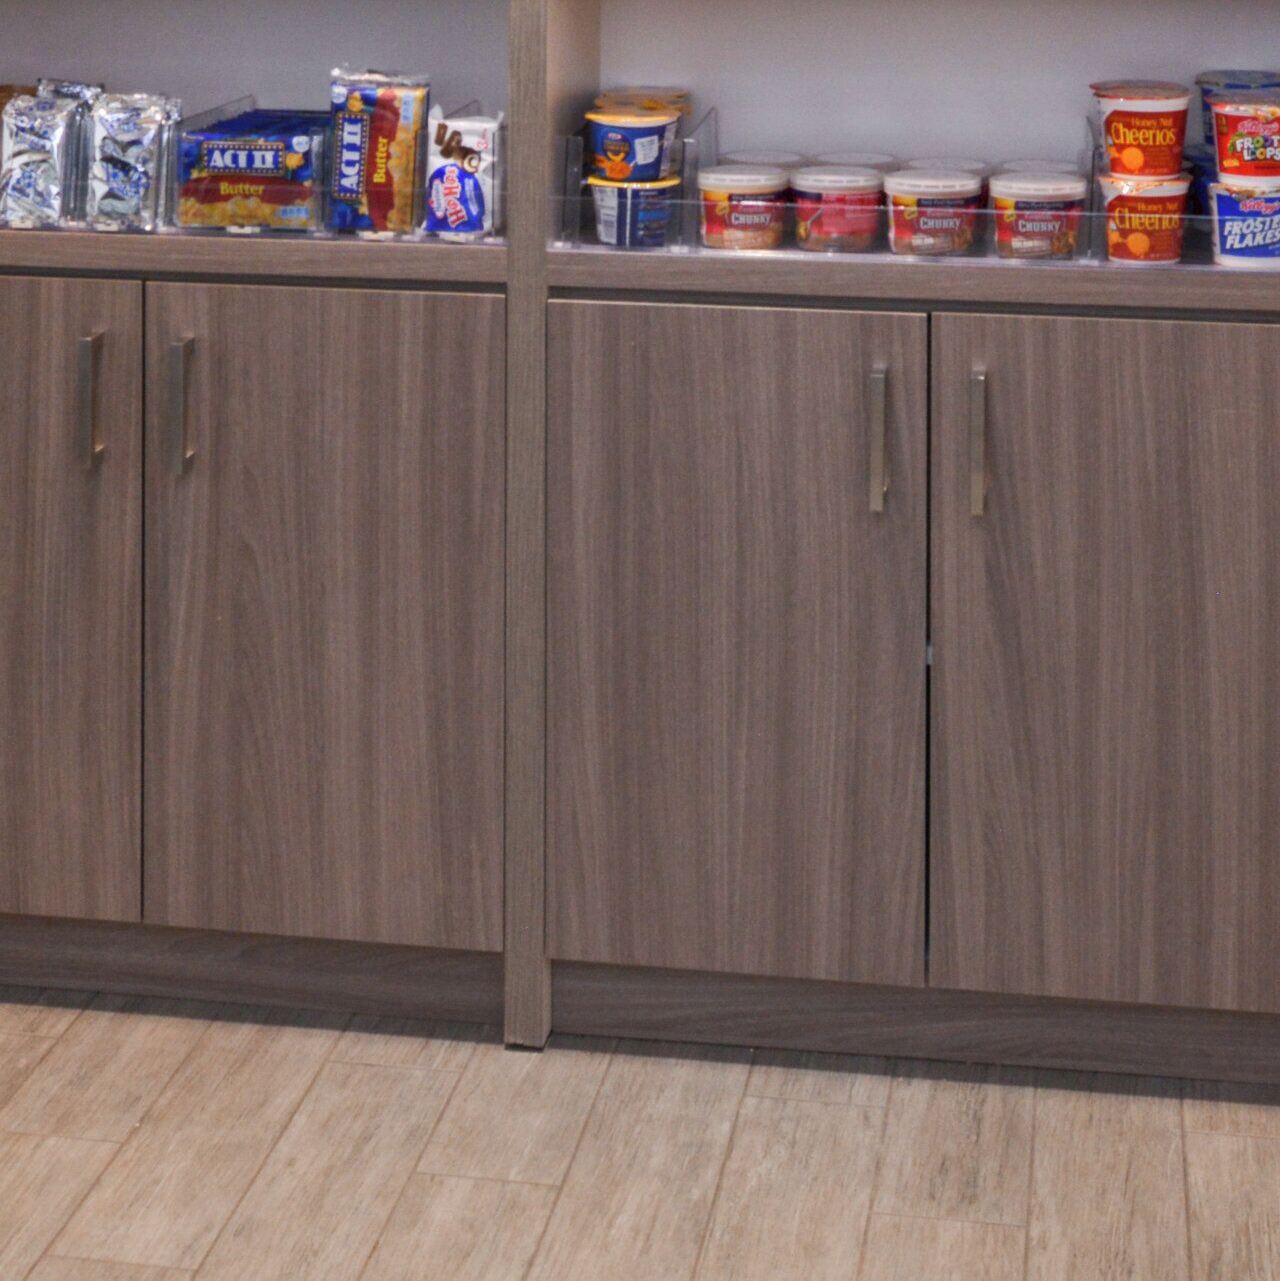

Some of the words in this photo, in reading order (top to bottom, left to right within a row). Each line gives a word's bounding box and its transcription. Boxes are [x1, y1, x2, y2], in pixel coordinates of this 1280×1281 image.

[1131, 118, 1158, 127] Honey
[1160, 118, 1173, 127] Nut
[1237, 120, 1279, 134] Kellogg's
[341, 122, 362, 146] II
[1111, 122, 1176, 145] Cheerios
[210, 150, 248, 169] ACT
[252, 150, 275, 169] II
[373, 136, 389, 184] Butter
[340, 151, 359, 192] ACT
[220, 182, 264, 196] Butter
[1239, 200, 1280, 213] Kellogg's
[920, 218, 961, 230] CHUNKY
[1019, 220, 1061, 233] CHUNKY
[1114, 207, 1180, 230] Cheerios
